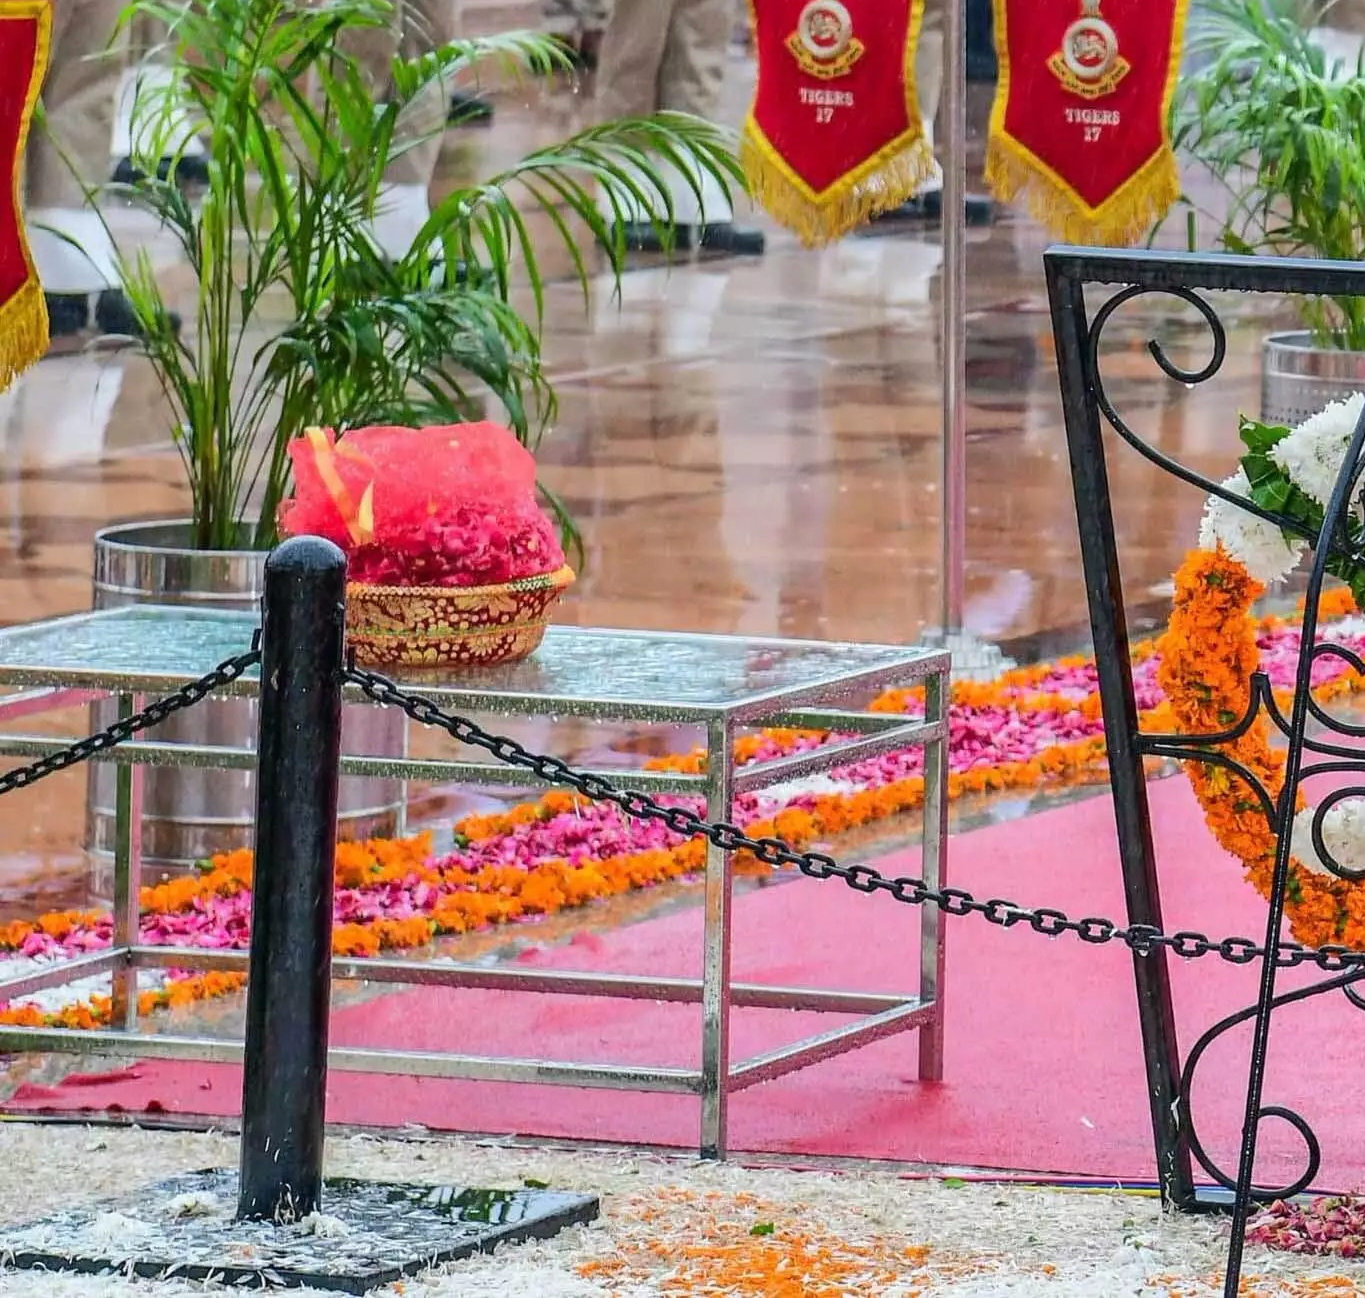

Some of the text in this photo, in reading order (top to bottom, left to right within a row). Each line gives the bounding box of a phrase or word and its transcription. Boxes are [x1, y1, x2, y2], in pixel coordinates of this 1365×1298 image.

[799, 88, 854, 106] TIGERS
[816, 107, 834, 123] 17
[1065, 108, 1120, 126] TIGERS
[1083, 126, 1102, 142] 17
